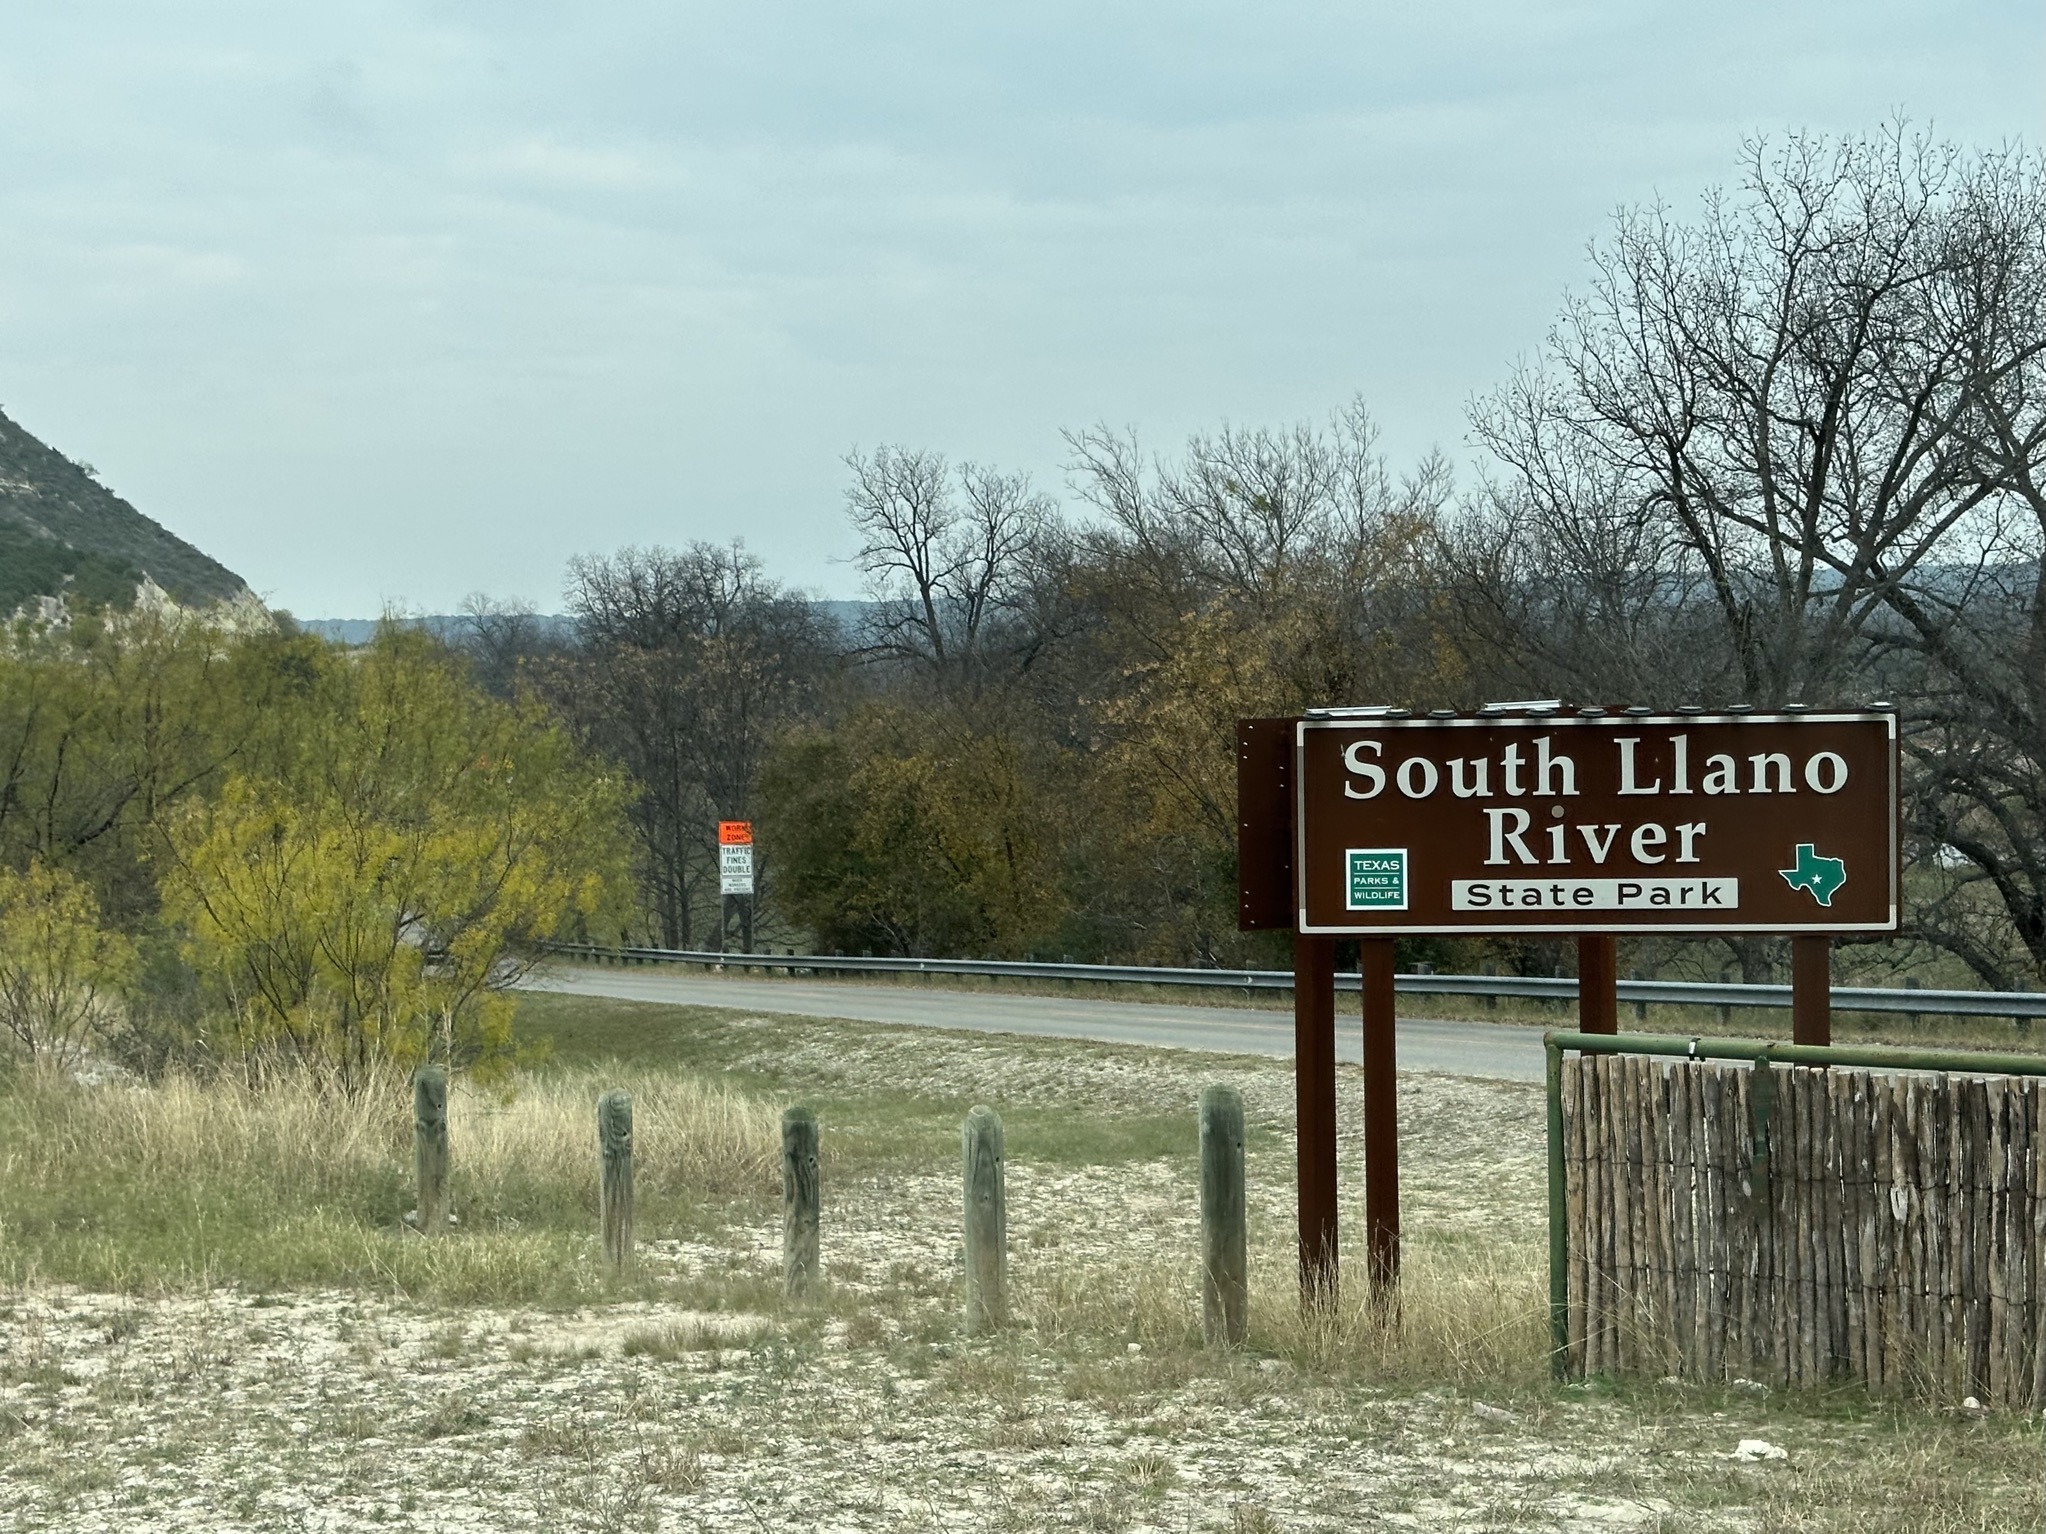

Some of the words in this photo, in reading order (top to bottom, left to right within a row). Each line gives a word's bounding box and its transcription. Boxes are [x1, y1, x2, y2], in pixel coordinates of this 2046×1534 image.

[1343, 738, 1580, 799] South
[1614, 734, 1849, 795] Llano
[1482, 805, 1707, 866] River
[1353, 860, 1400, 870] TEXAS
[1353, 877, 1388, 885] PARKS
[1392, 877, 1400, 885] &
[1354, 891, 1400, 899] WILDLIFE
[1467, 882, 1594, 907] State
[1616, 881, 1723, 906] Park
